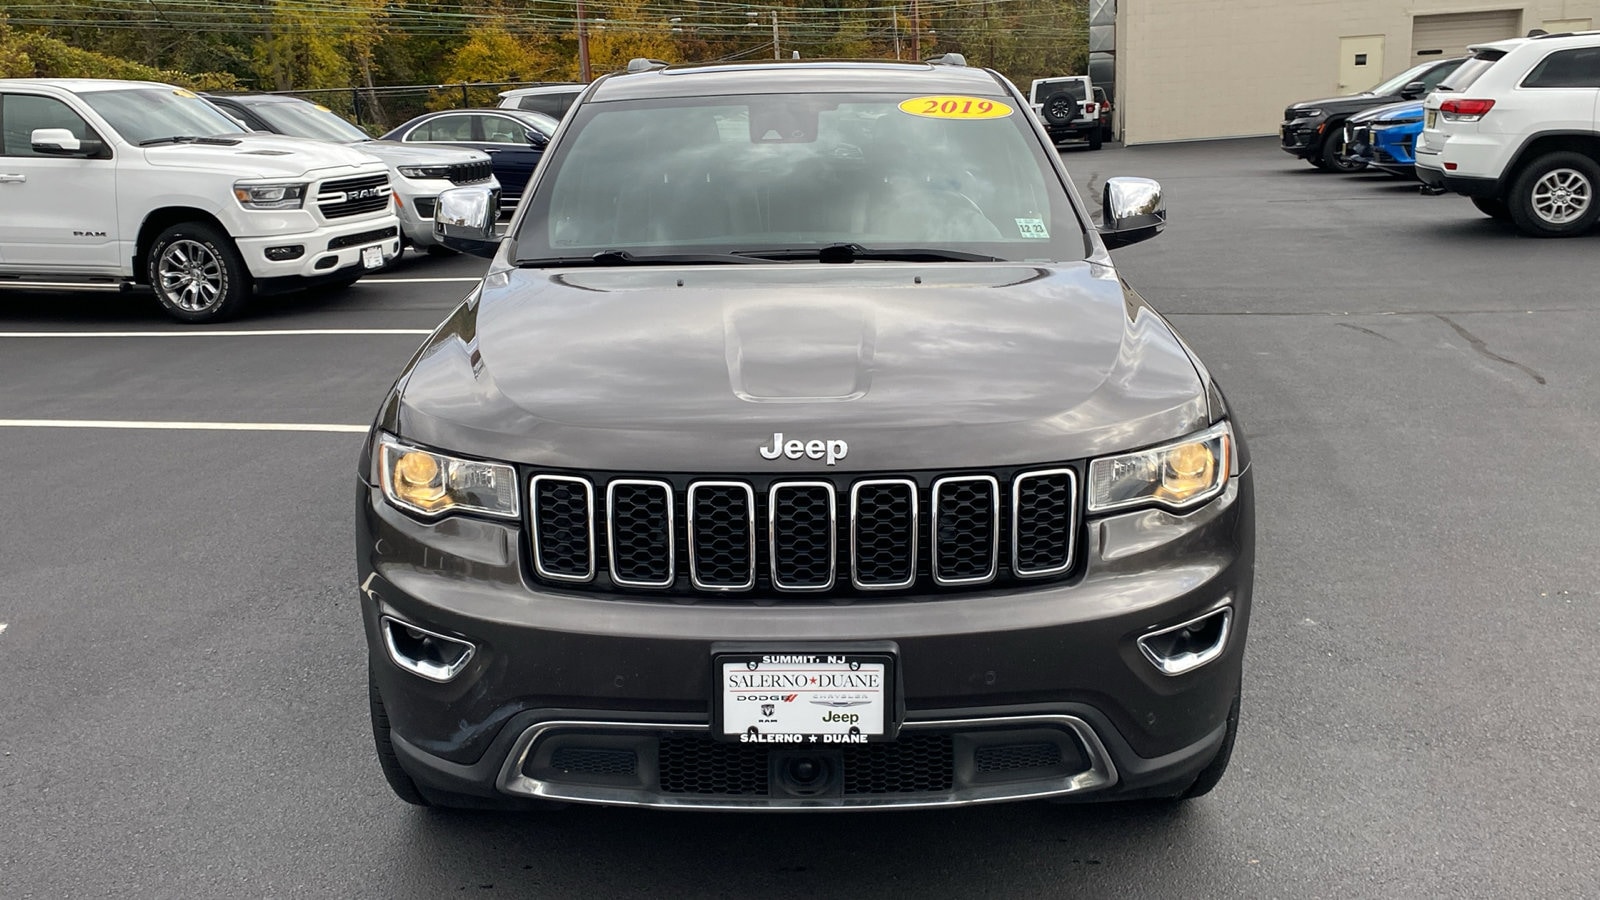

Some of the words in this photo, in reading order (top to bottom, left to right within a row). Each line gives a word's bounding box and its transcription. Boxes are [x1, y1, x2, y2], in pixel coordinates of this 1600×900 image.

[922, 100, 993, 114] 2019
[347, 188, 382, 201] RAM
[1020, 224, 1032, 233] 12
[759, 432, 848, 466] Jeep
[762, 655, 820, 664] SUMMIT,
[827, 655, 846, 664] NJ
[729, 674, 808, 688] SALERNO
[819, 674, 879, 688] DUANE
[822, 710, 859, 725] Jeep
[740, 733, 803, 743] SALERNO
[823, 734, 868, 743] DUANE
